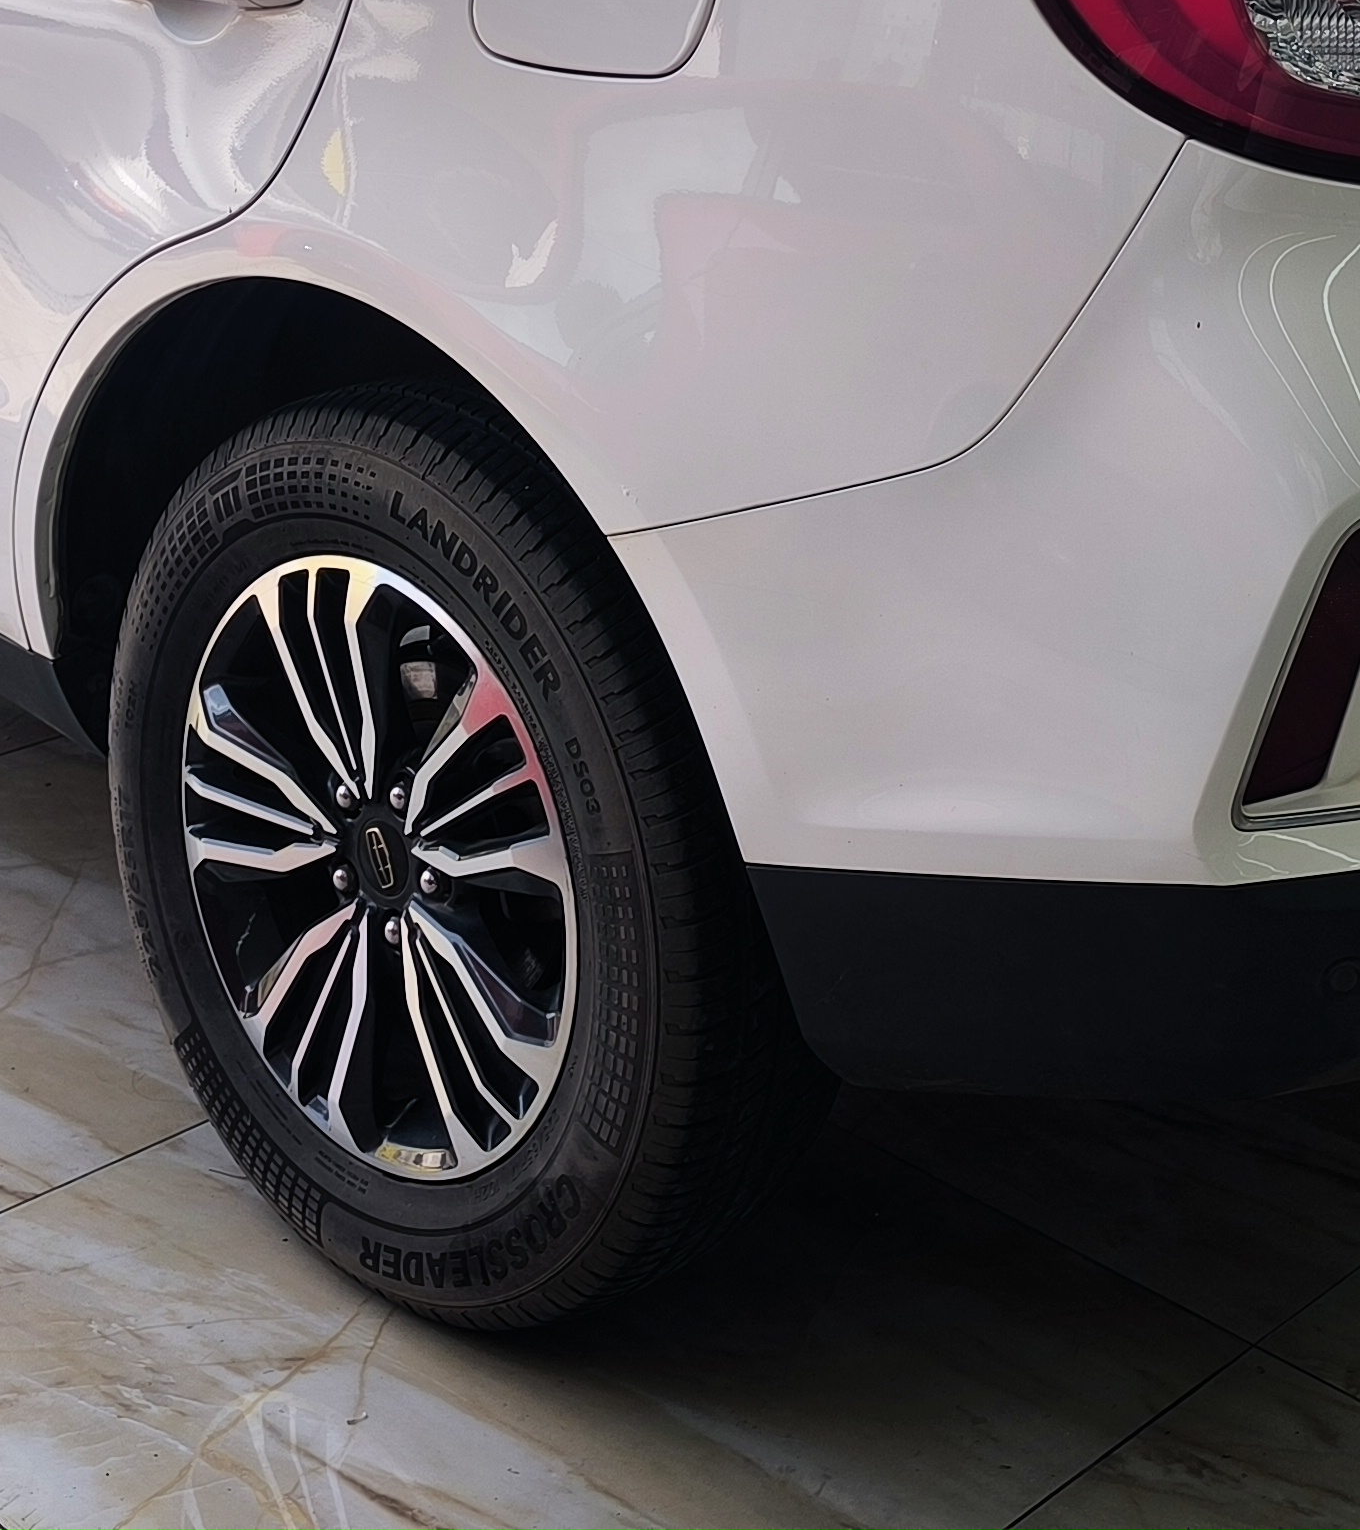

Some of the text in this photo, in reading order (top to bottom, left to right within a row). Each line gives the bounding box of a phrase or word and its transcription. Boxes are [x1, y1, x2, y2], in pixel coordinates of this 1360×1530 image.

[390, 490, 562, 700] LANDRIDER
[116, 784, 164, 985] 225/65R17
[358, 1173, 581, 1289] CROSSLEADER
